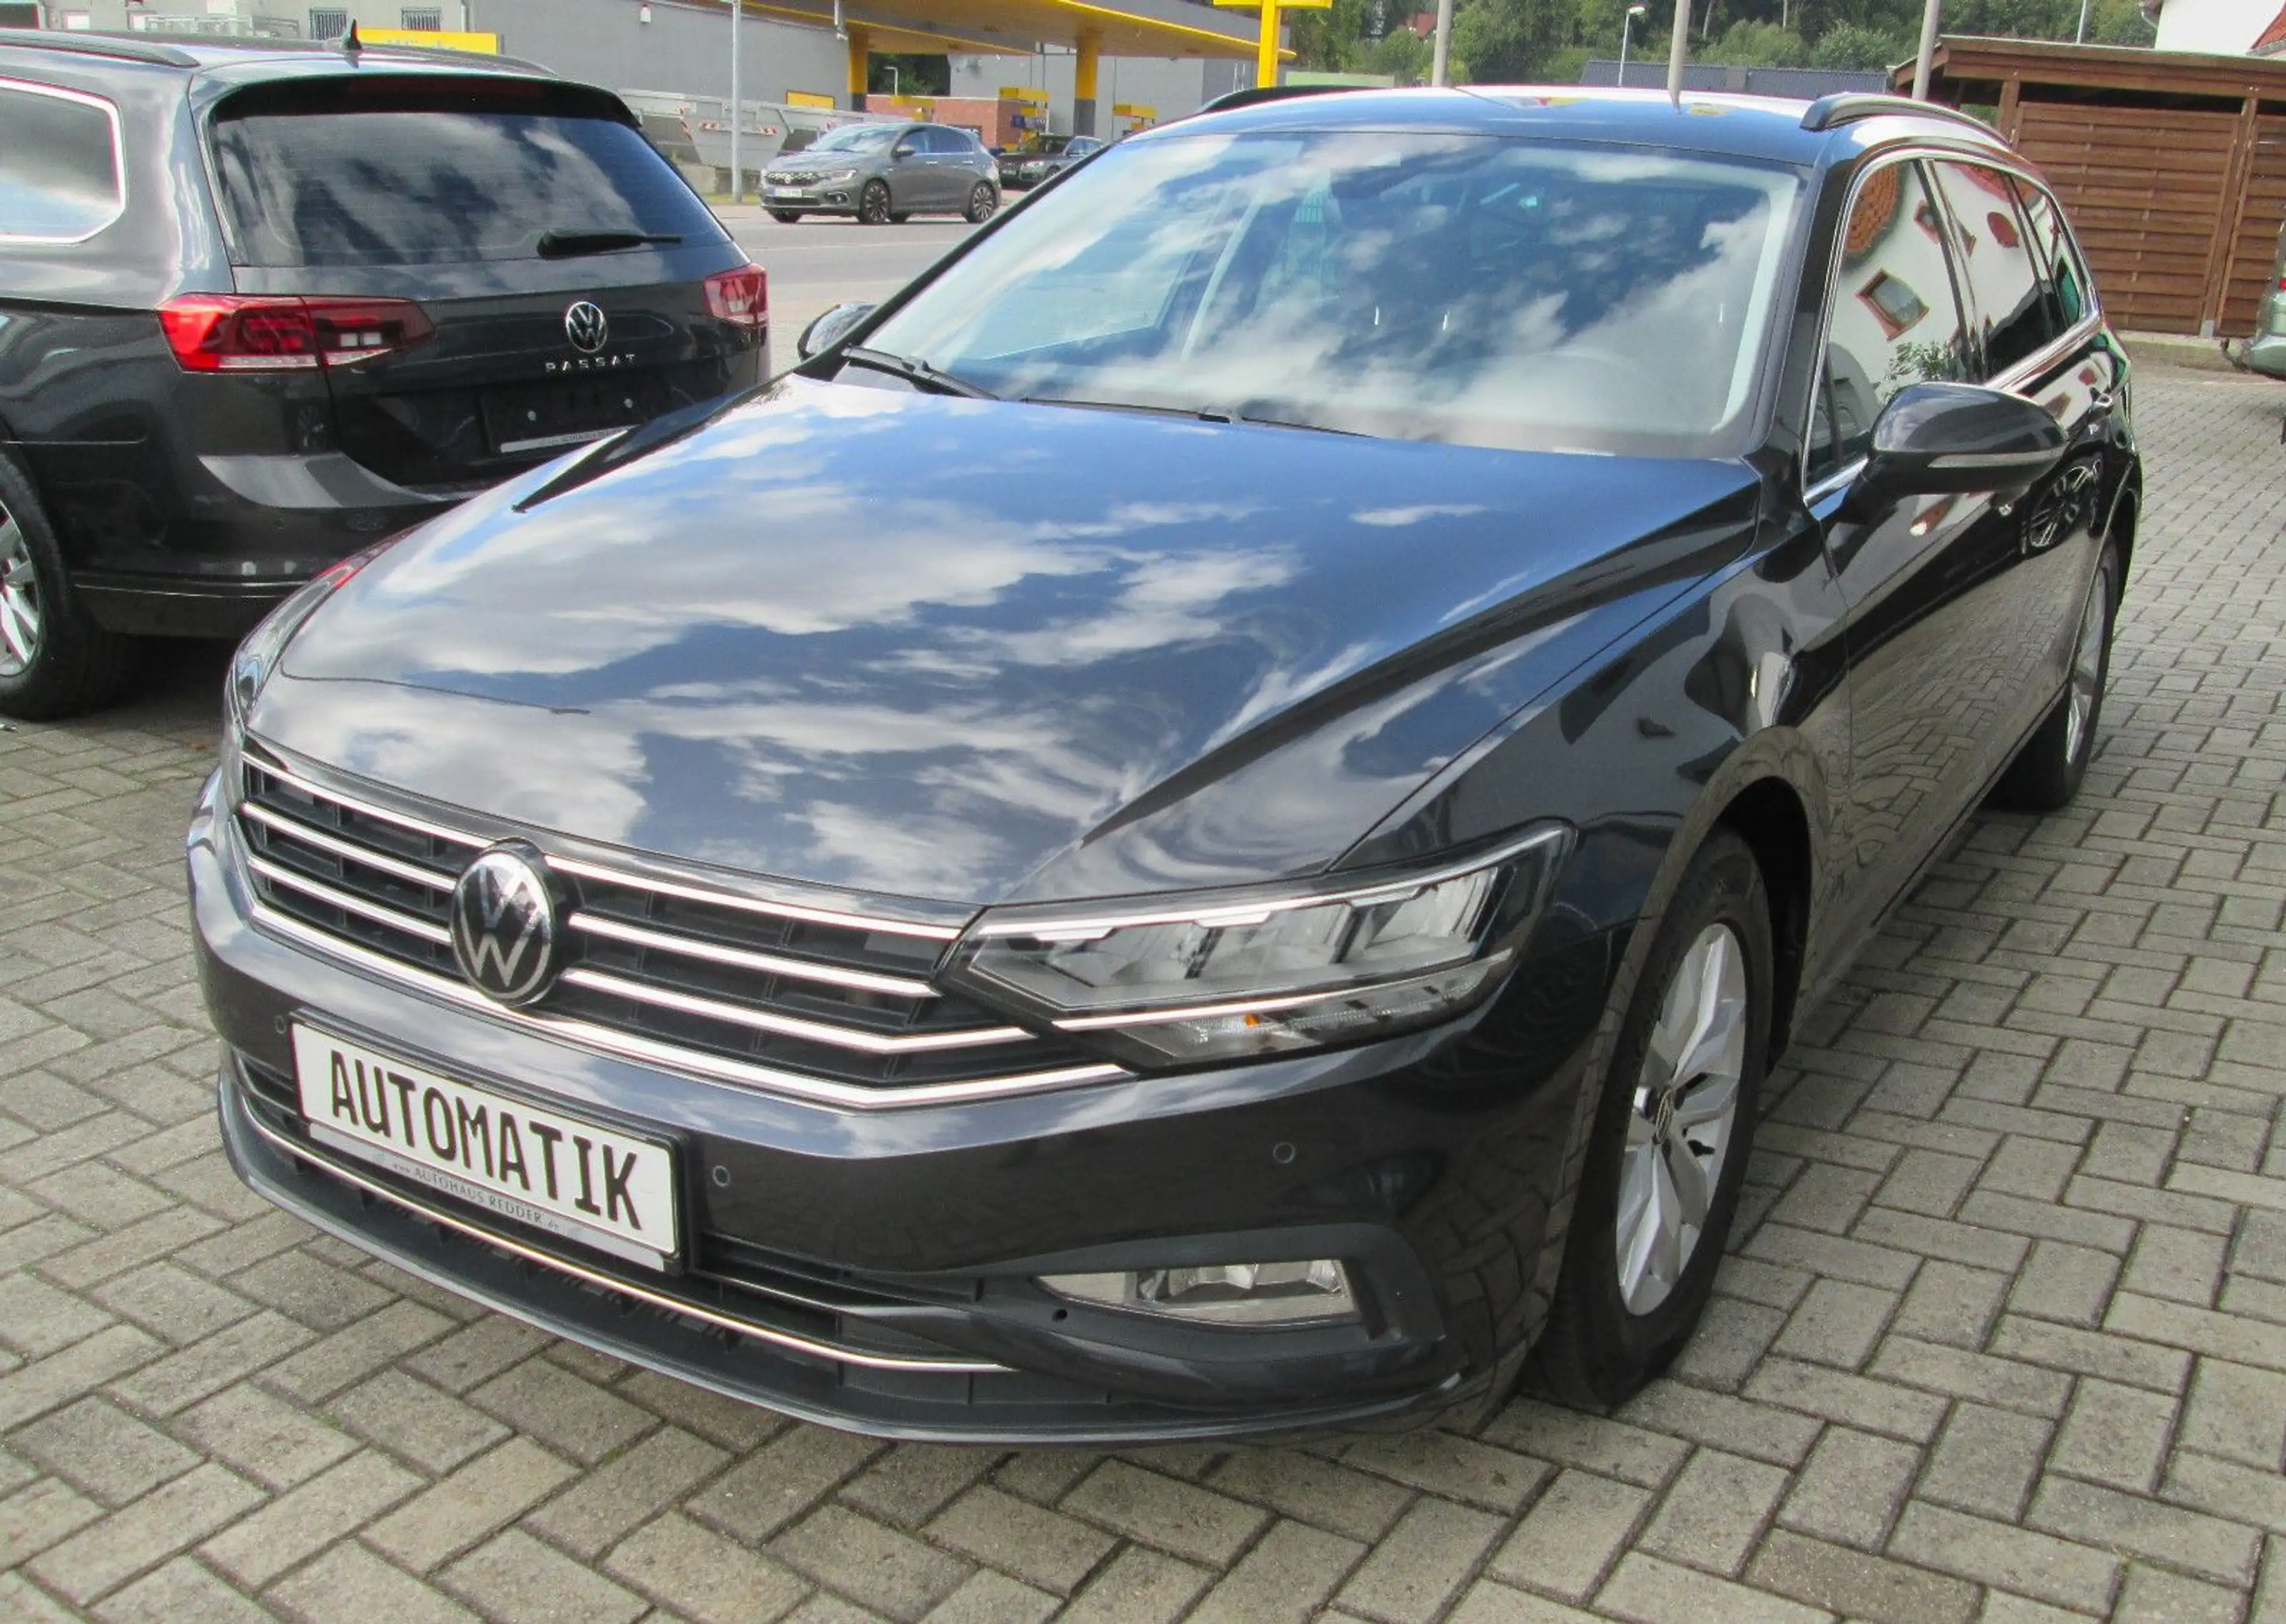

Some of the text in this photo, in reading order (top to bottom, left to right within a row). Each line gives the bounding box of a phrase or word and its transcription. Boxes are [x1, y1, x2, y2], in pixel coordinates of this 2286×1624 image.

[546, 354, 635, 372] PASSAT
[567, 302, 606, 350] VW
[456, 855, 551, 993] VW
[330, 1050, 642, 1231] AUTOMATIK
